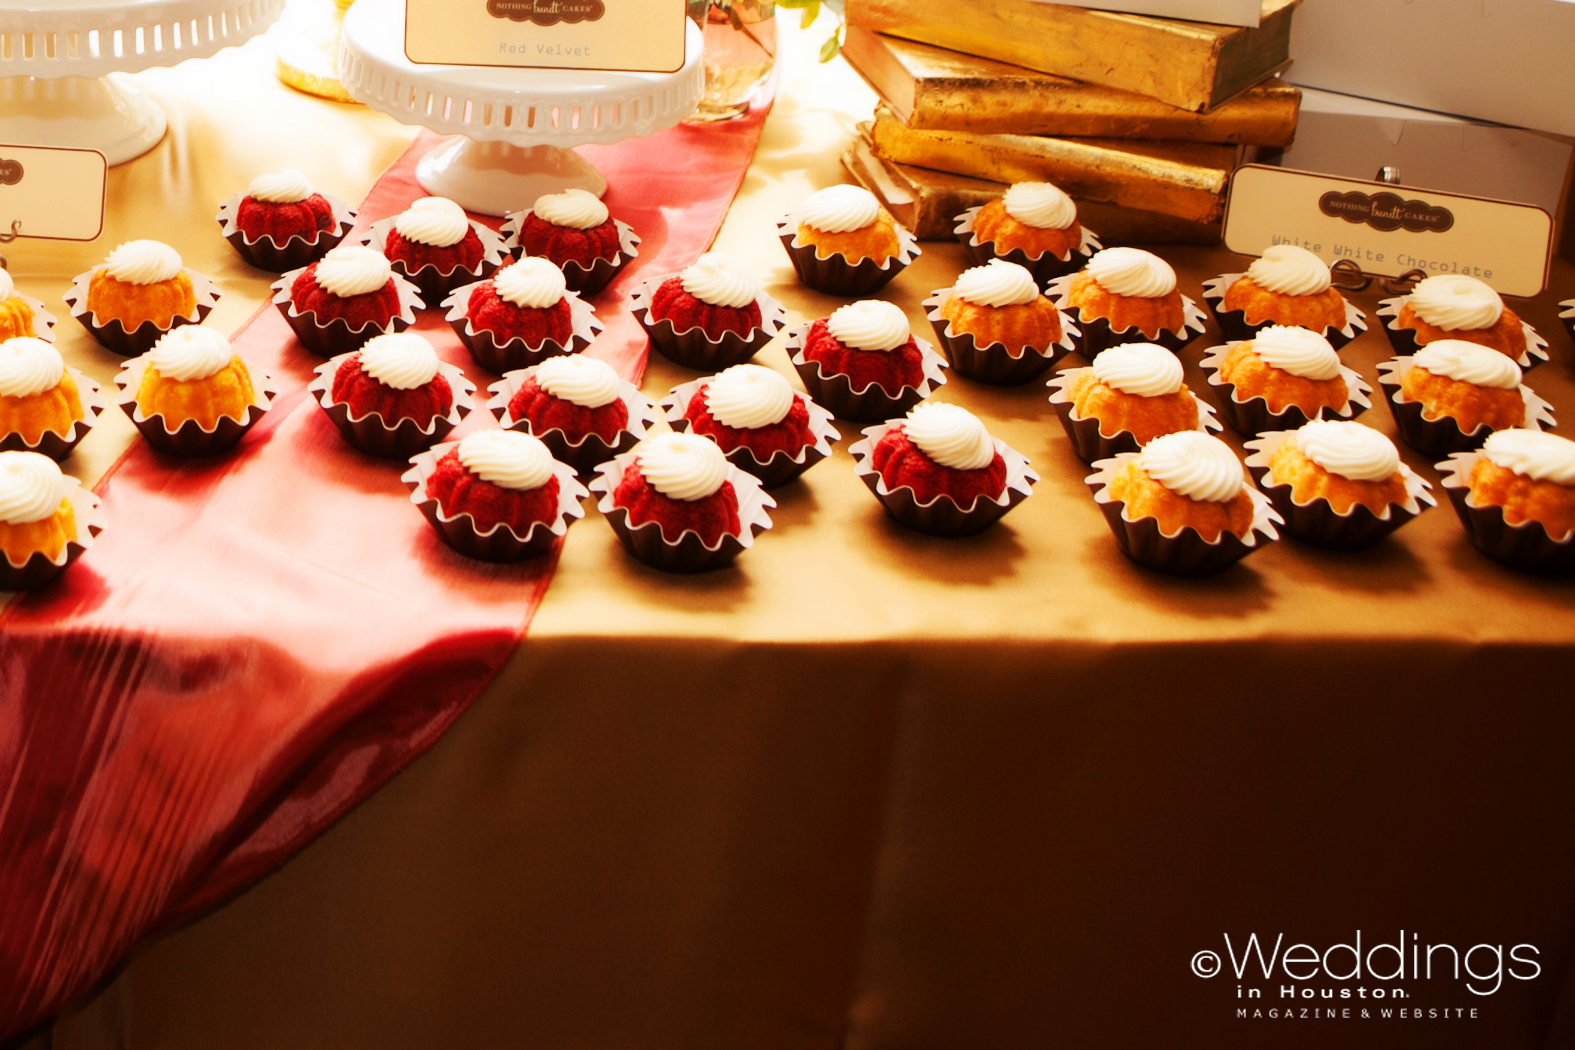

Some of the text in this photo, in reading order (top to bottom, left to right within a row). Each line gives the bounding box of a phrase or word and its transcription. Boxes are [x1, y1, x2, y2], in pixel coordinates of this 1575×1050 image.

[496, 2, 532, 10] NOTHING
[499, 42, 591, 56] Red Velvet
[1329, 200, 1370, 213] NOTHING
[1371, 201, 1405, 220] bundt
[1334, 244, 1385, 262] White
[1396, 254, 1494, 279] Chocolate
